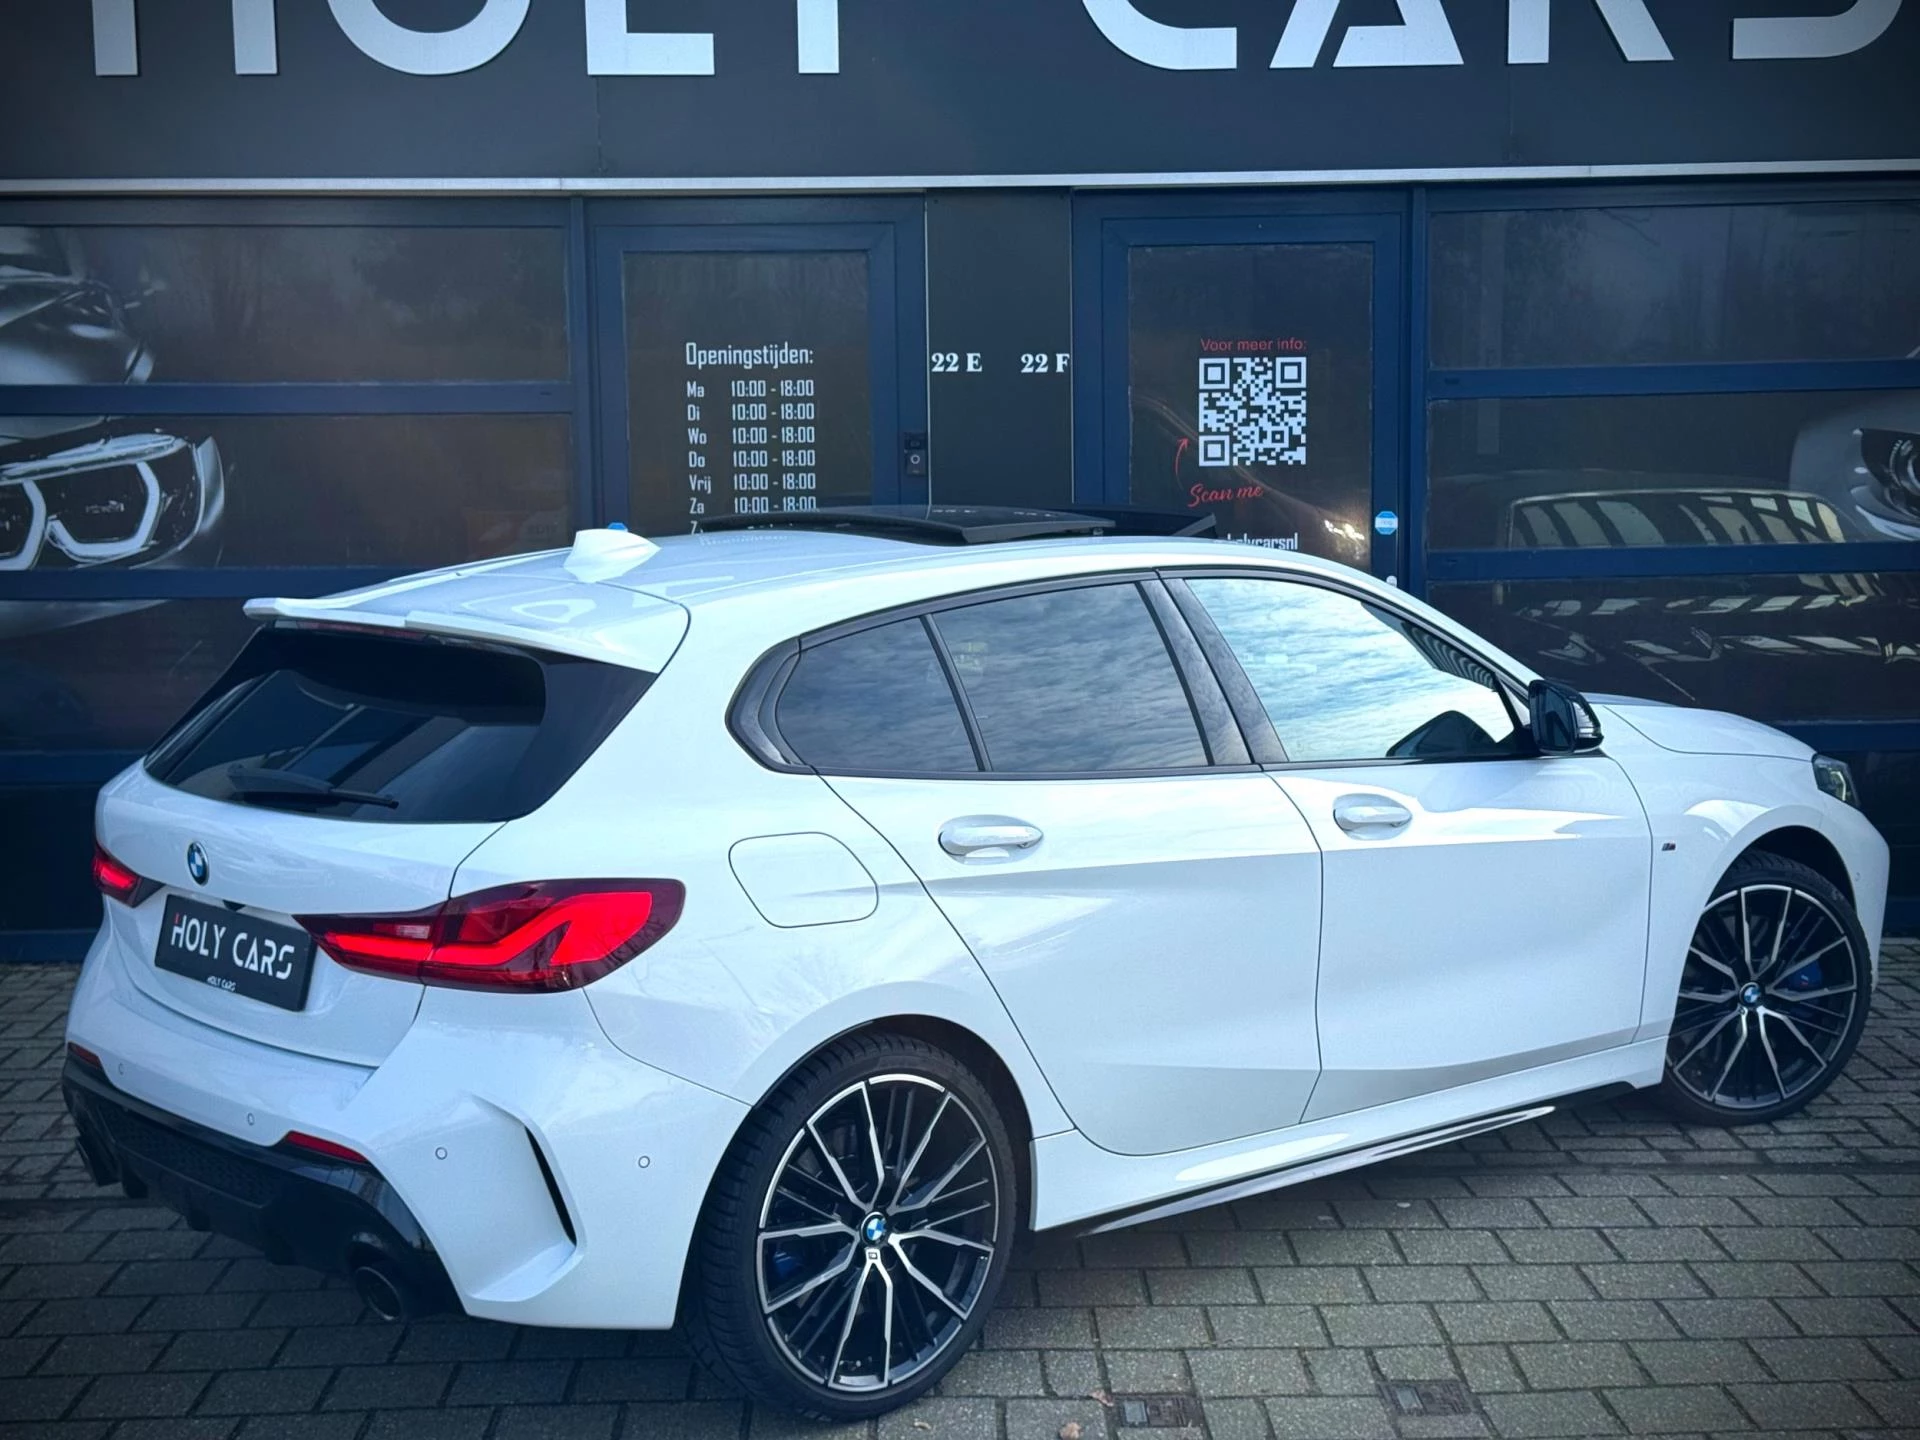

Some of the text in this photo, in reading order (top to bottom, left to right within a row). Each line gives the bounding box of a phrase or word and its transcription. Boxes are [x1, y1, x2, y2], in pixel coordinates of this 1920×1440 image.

[1200, 337, 1307, 352] Voor meer info:
[685, 341, 814, 370] Openingstijden:
[931, 352, 983, 372] 22 E
[1020, 353, 1070, 373] 22 F
[686, 380, 705, 398] Ma
[731, 379, 767, 397] 10:00
[780, 379, 815, 397] 18:00
[687, 404, 700, 421] Di
[731, 403, 767, 421] 10:00
[781, 402, 815, 420] 18:00
[688, 427, 707, 445] Wo
[732, 427, 768, 444] 10:00
[781, 426, 816, 444] 18:00
[688, 451, 706, 468] Do
[733, 450, 768, 467] 10:00
[782, 449, 816, 467] 18:00
[689, 474, 712, 494] Vrij
[734, 473, 769, 490] 10:00
[782, 472, 816, 490] 18:00
[689, 497, 705, 514] Za
[734, 496, 770, 514] 10:00
[783, 496, 817, 512] 18:00
[1187, 483, 1263, 508] Scan me
[170, 912, 295, 980] HOLY CARS
